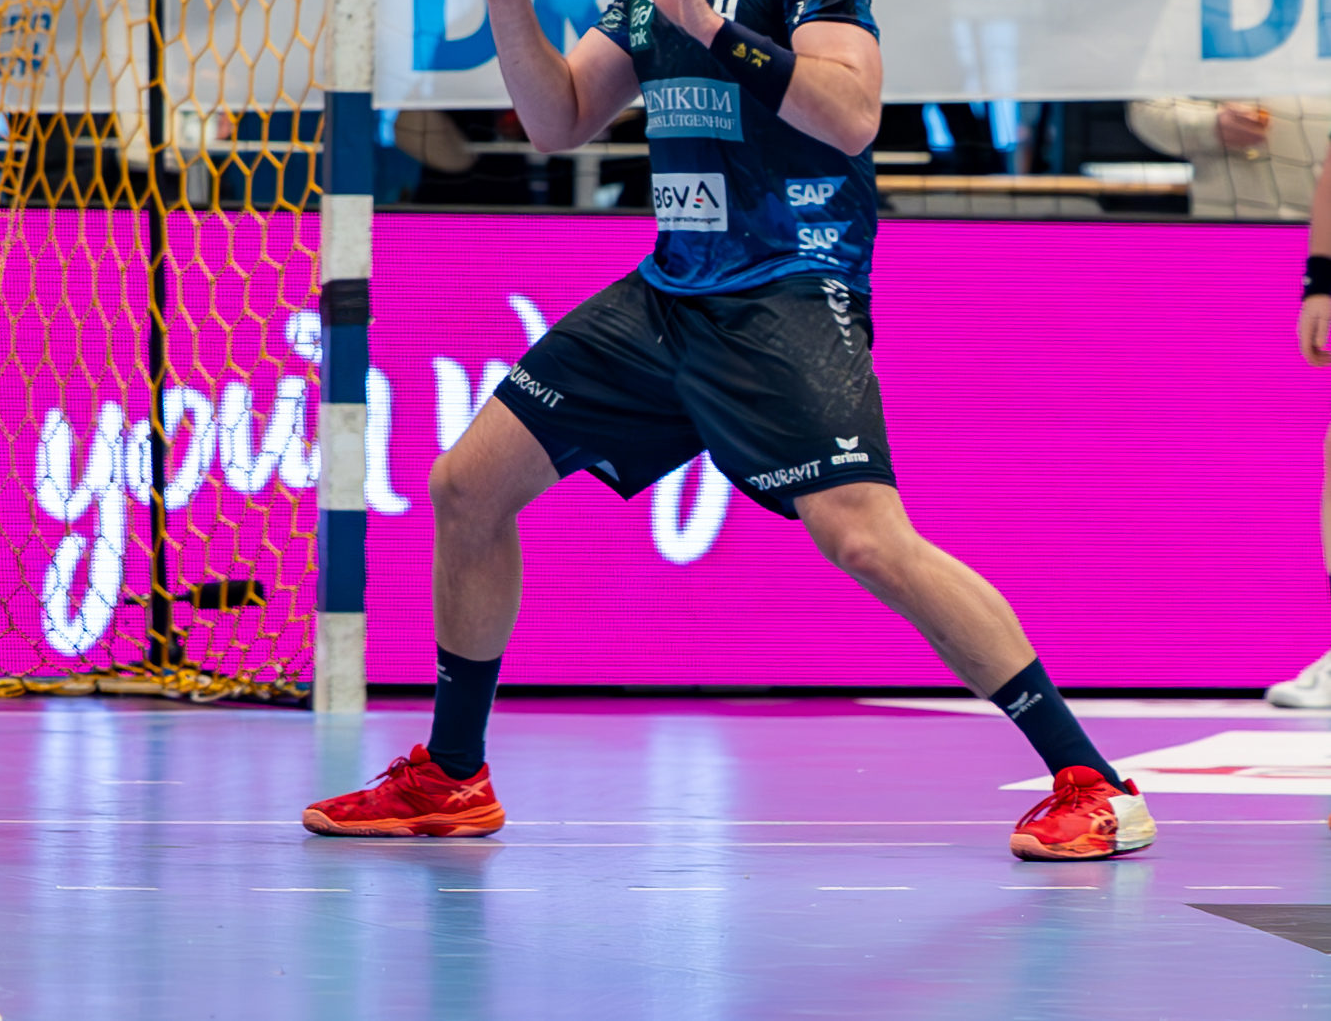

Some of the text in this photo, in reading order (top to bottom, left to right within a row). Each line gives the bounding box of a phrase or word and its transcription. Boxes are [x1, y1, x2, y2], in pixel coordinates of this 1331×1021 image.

[787, 183, 835, 207] SAP
[798, 227, 839, 250] SAP
[831, 452, 869, 465] erima
